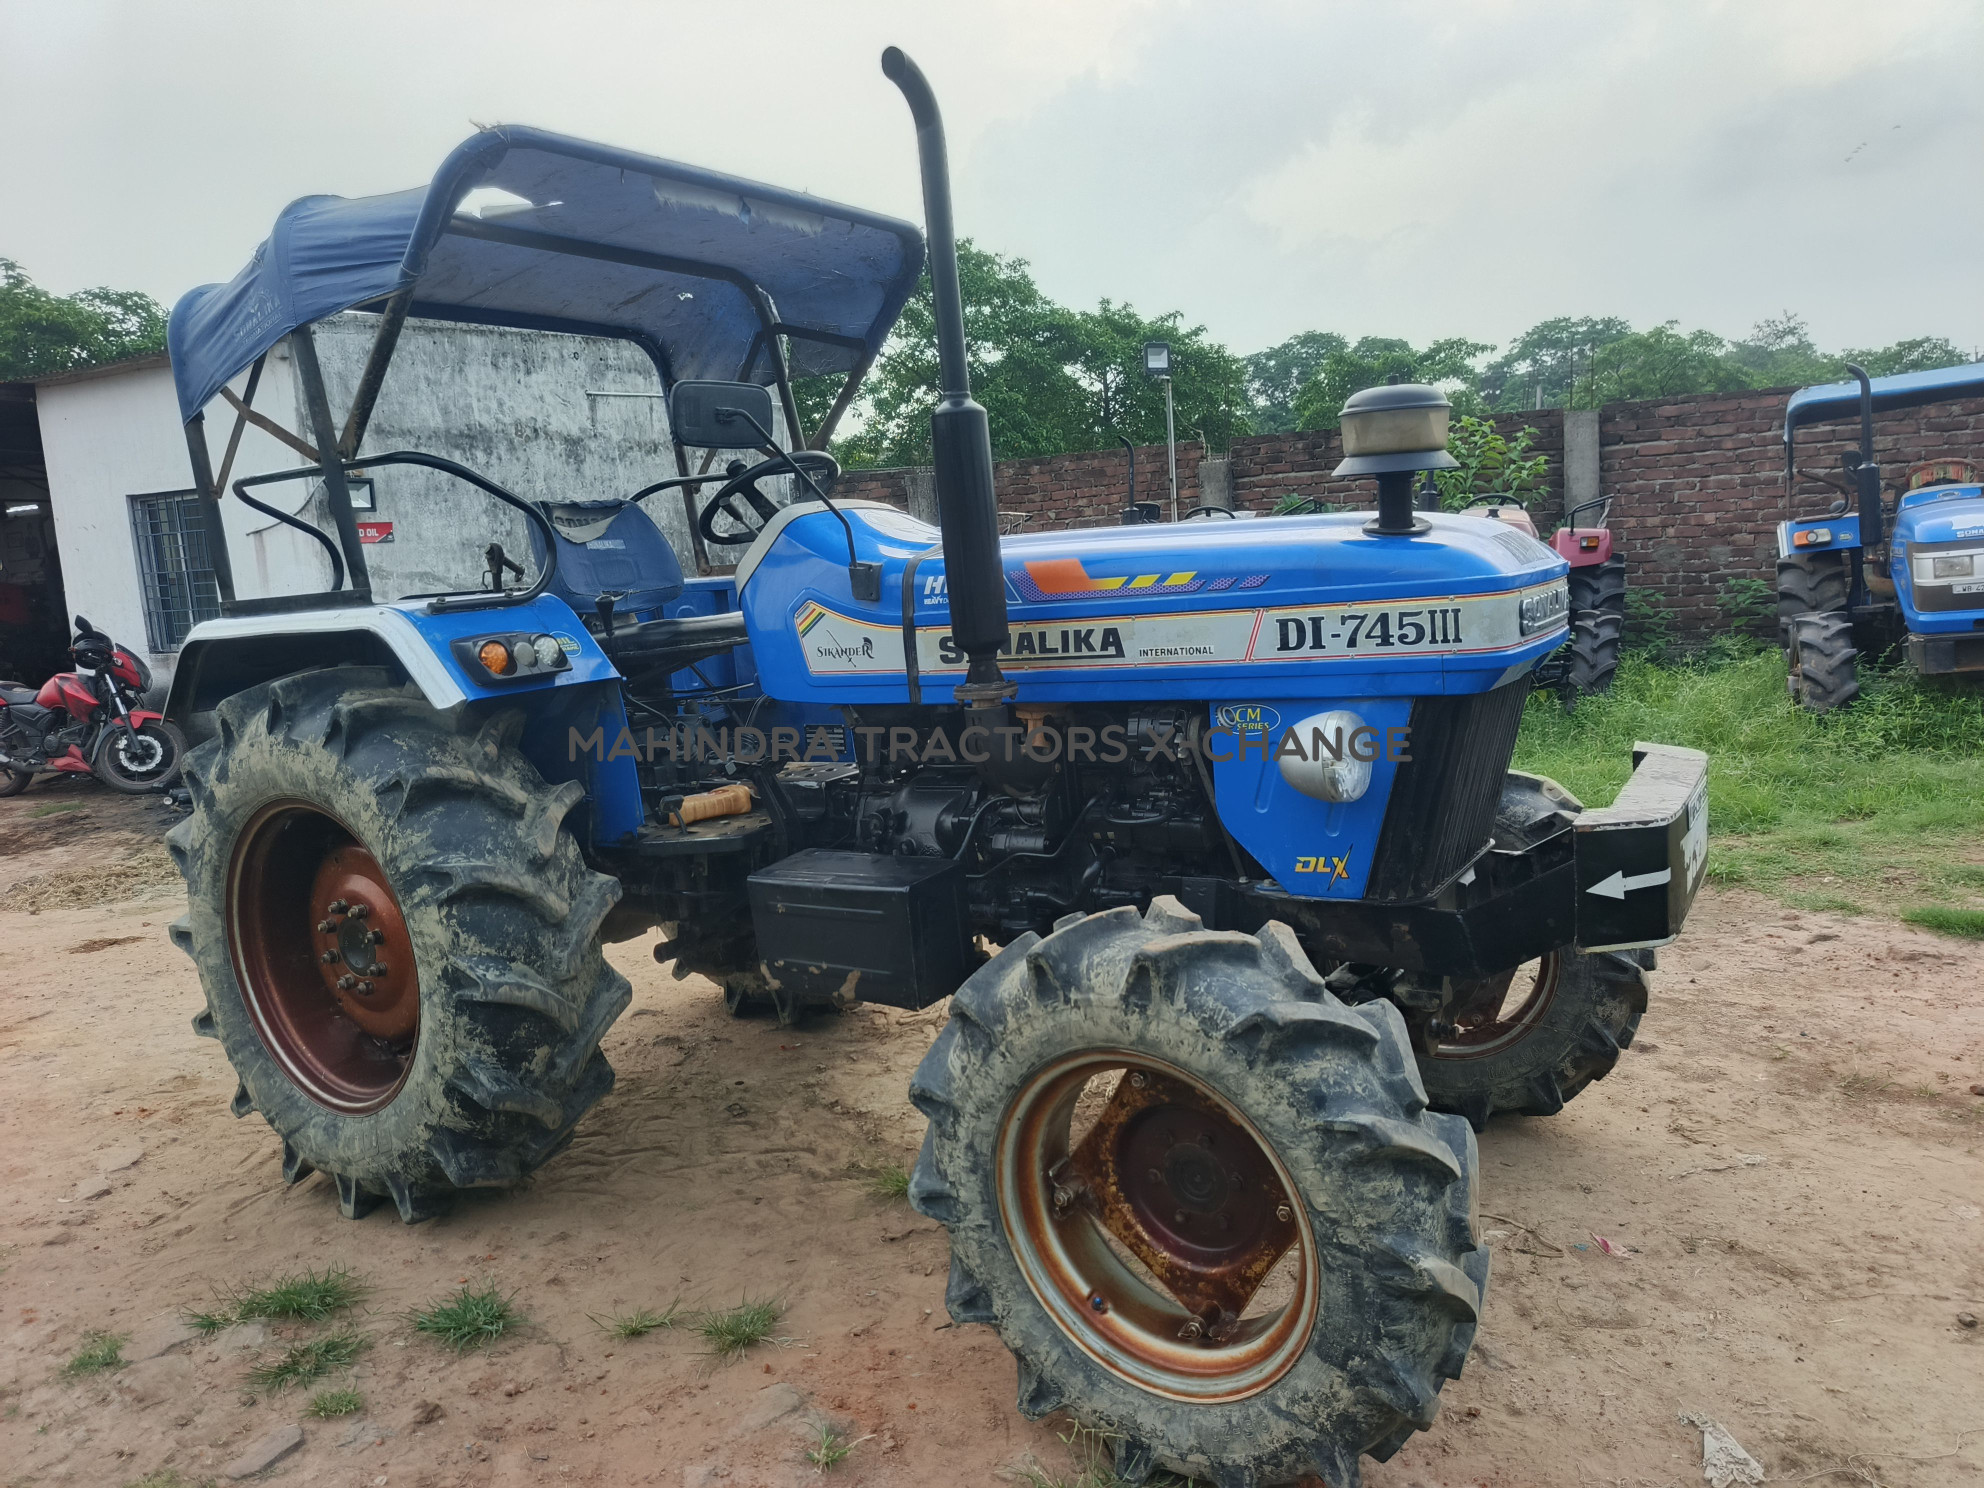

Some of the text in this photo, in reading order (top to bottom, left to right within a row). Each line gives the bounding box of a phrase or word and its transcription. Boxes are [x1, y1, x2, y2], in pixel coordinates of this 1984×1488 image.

[366, 528, 379, 537] OIL
[1276, 607, 1463, 652] DI-745III
[817, 640, 875, 661] SIKANDER
[1139, 646, 1214, 657] INTERNATIONAL
[1235, 707, 1261, 723] CM
[1236, 721, 1270, 731] SERIES
[1294, 847, 1354, 886] DLX
